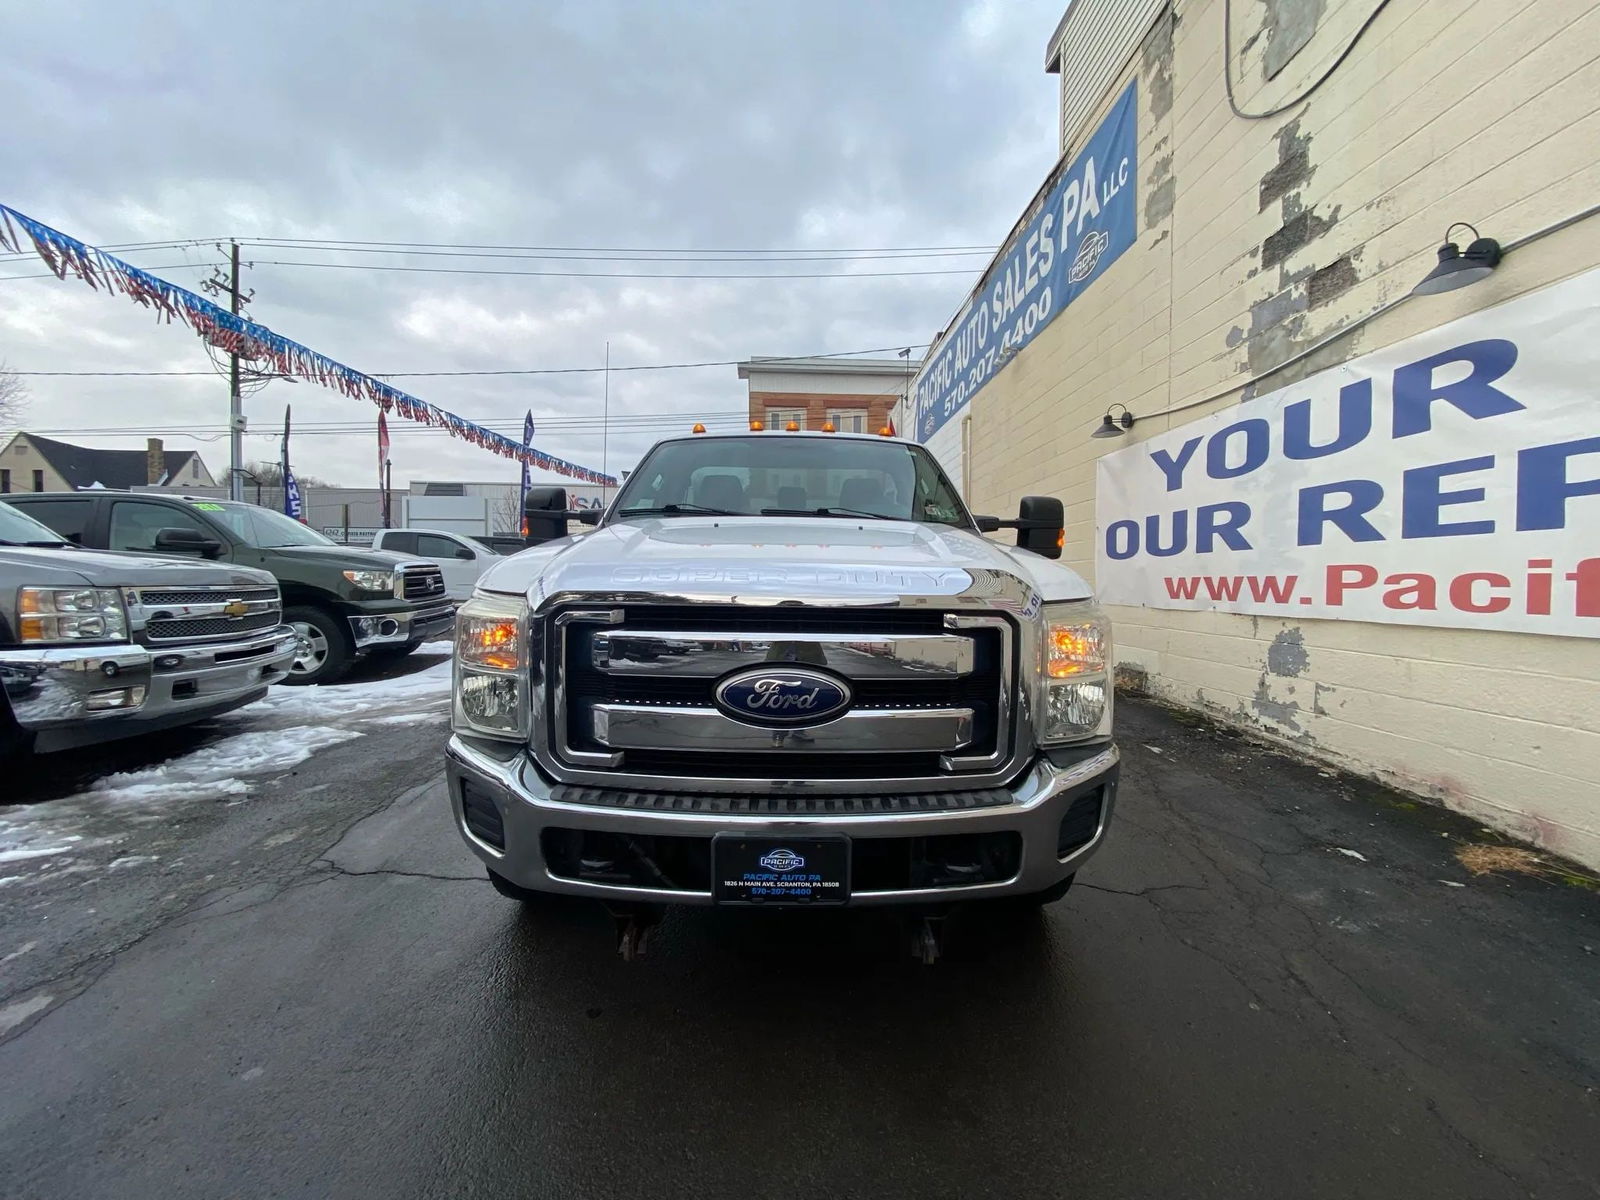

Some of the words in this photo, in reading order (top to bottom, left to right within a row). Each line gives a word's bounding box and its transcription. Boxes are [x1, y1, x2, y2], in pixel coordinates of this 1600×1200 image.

[1071, 238, 1104, 279] PACIFIC
[919, 350, 953, 419] PACIFIC
[954, 303, 988, 376] AUTO
[992, 213, 1053, 332] SALES
[1060, 156, 1100, 253] PA
[1103, 157, 1128, 206] LLC
[1149, 339, 1527, 492] YOUR
[1105, 501, 1253, 561] OUR
[611, 567, 789, 585] SUPER
[816, 569, 948, 587] DUTY
[746, 678, 819, 710] Ford
[743, 873, 778, 881] PACIFIC
